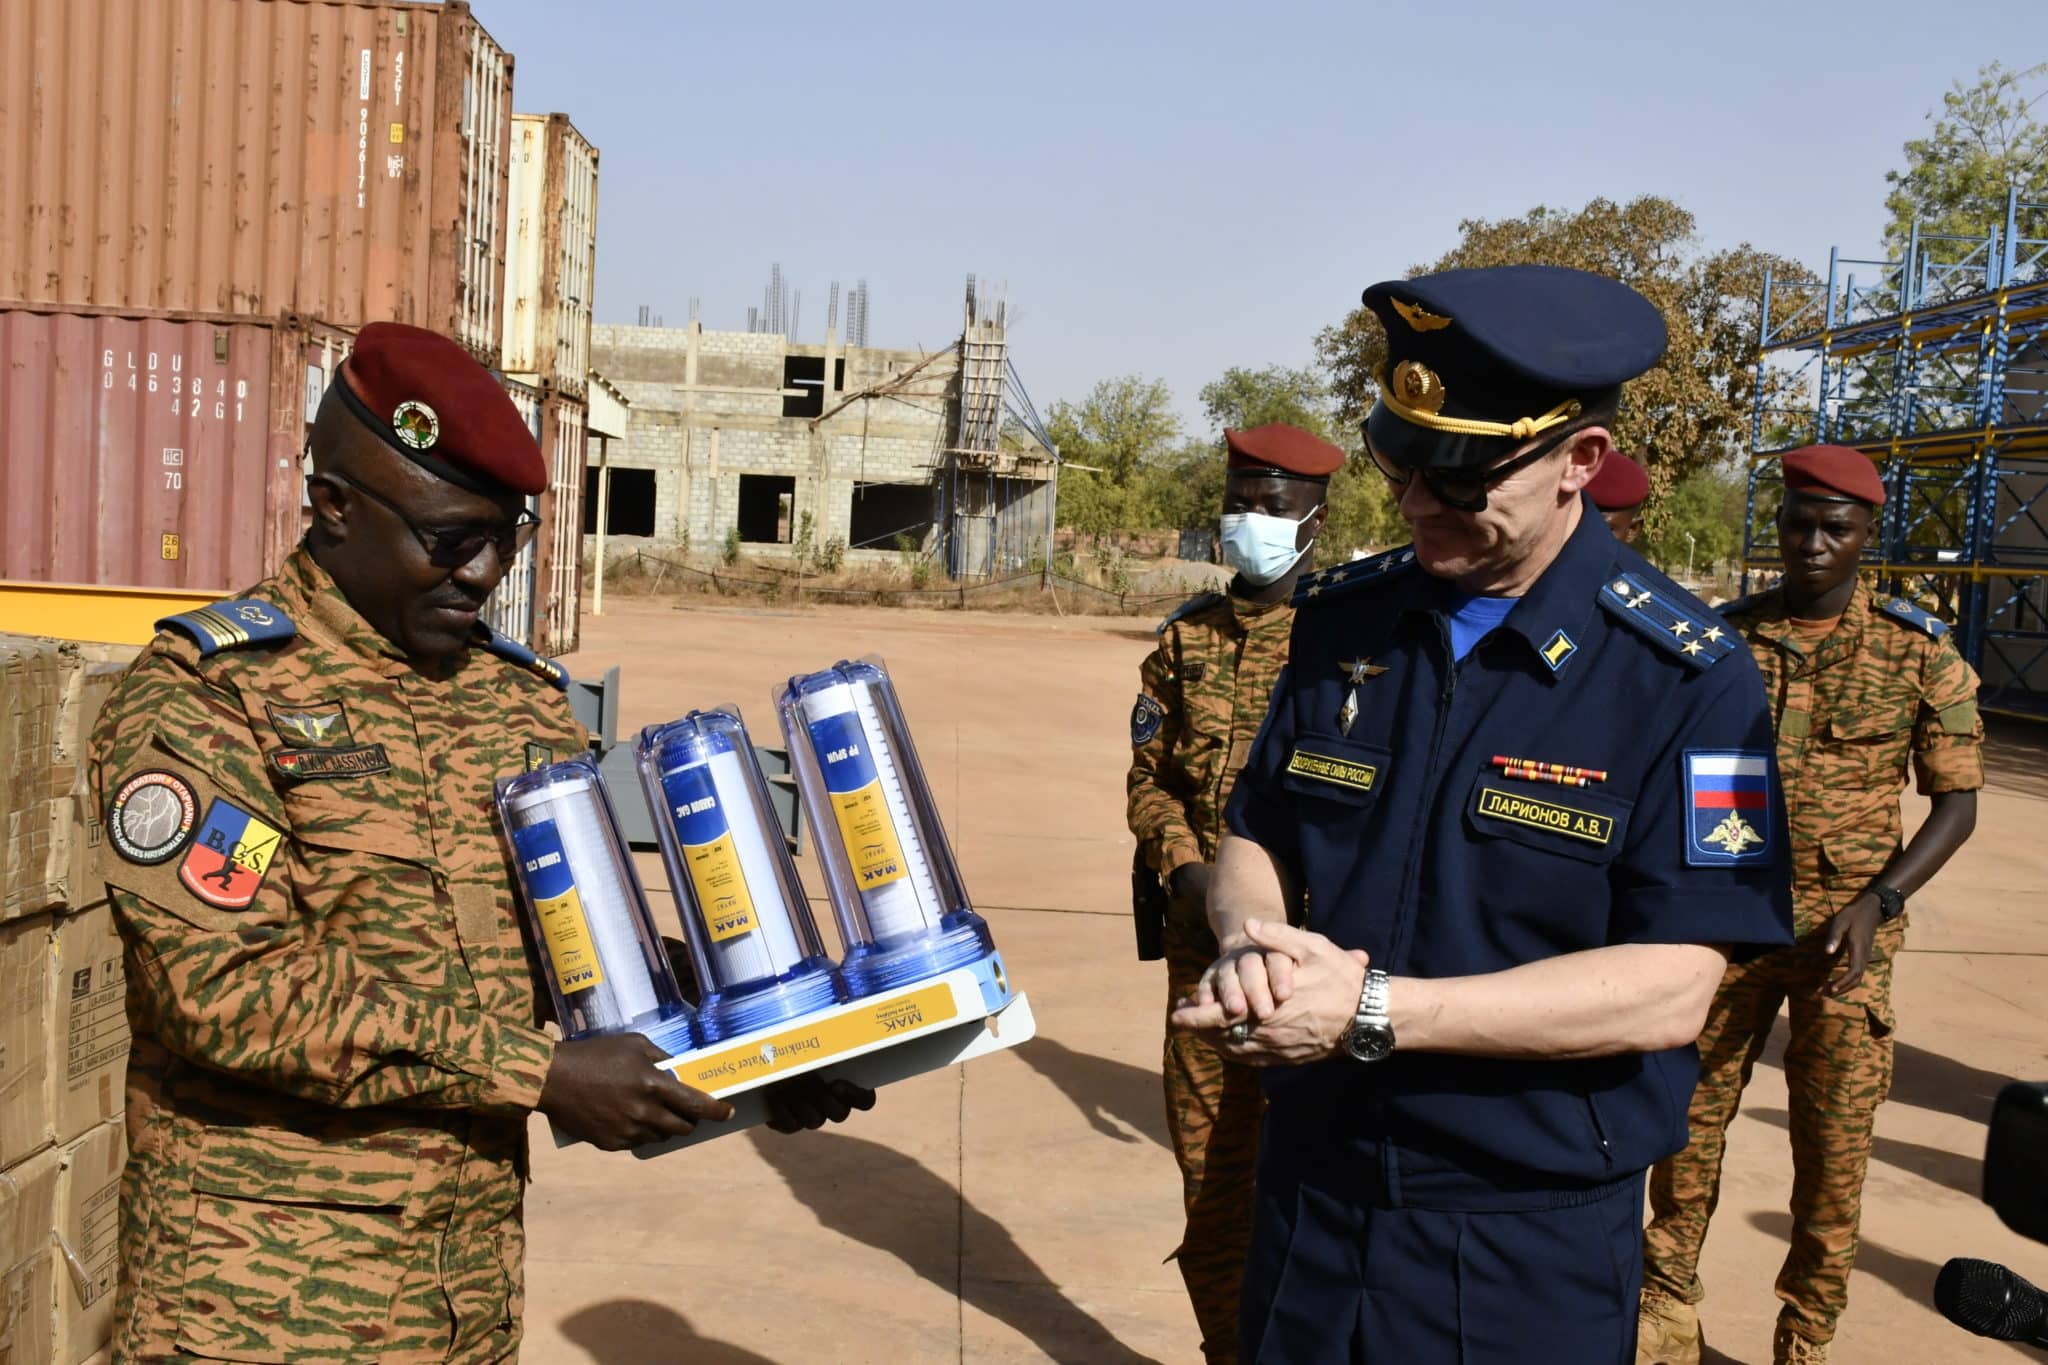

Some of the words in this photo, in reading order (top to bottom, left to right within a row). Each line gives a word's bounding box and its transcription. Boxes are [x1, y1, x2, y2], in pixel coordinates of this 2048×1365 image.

[358, 108, 368, 208] 9066171
[104, 350, 182, 372] GLDU
[104, 372, 247, 399] 0463840
[171, 398, 242, 422] 42G1
[165, 472, 182, 489] 70
[1488, 795, 1571, 828] ЛАРИОНОВ
[1573, 817, 1602, 837] А.В.
[863, 863, 898, 881] MAK
[715, 915, 749, 933] MAK
[562, 969, 594, 986] MAK
[883, 1011, 922, 1033] MAK
[771, 1037, 820, 1058] Drinking
[738, 1052, 771, 1067] Water
[698, 1062, 737, 1080] System
